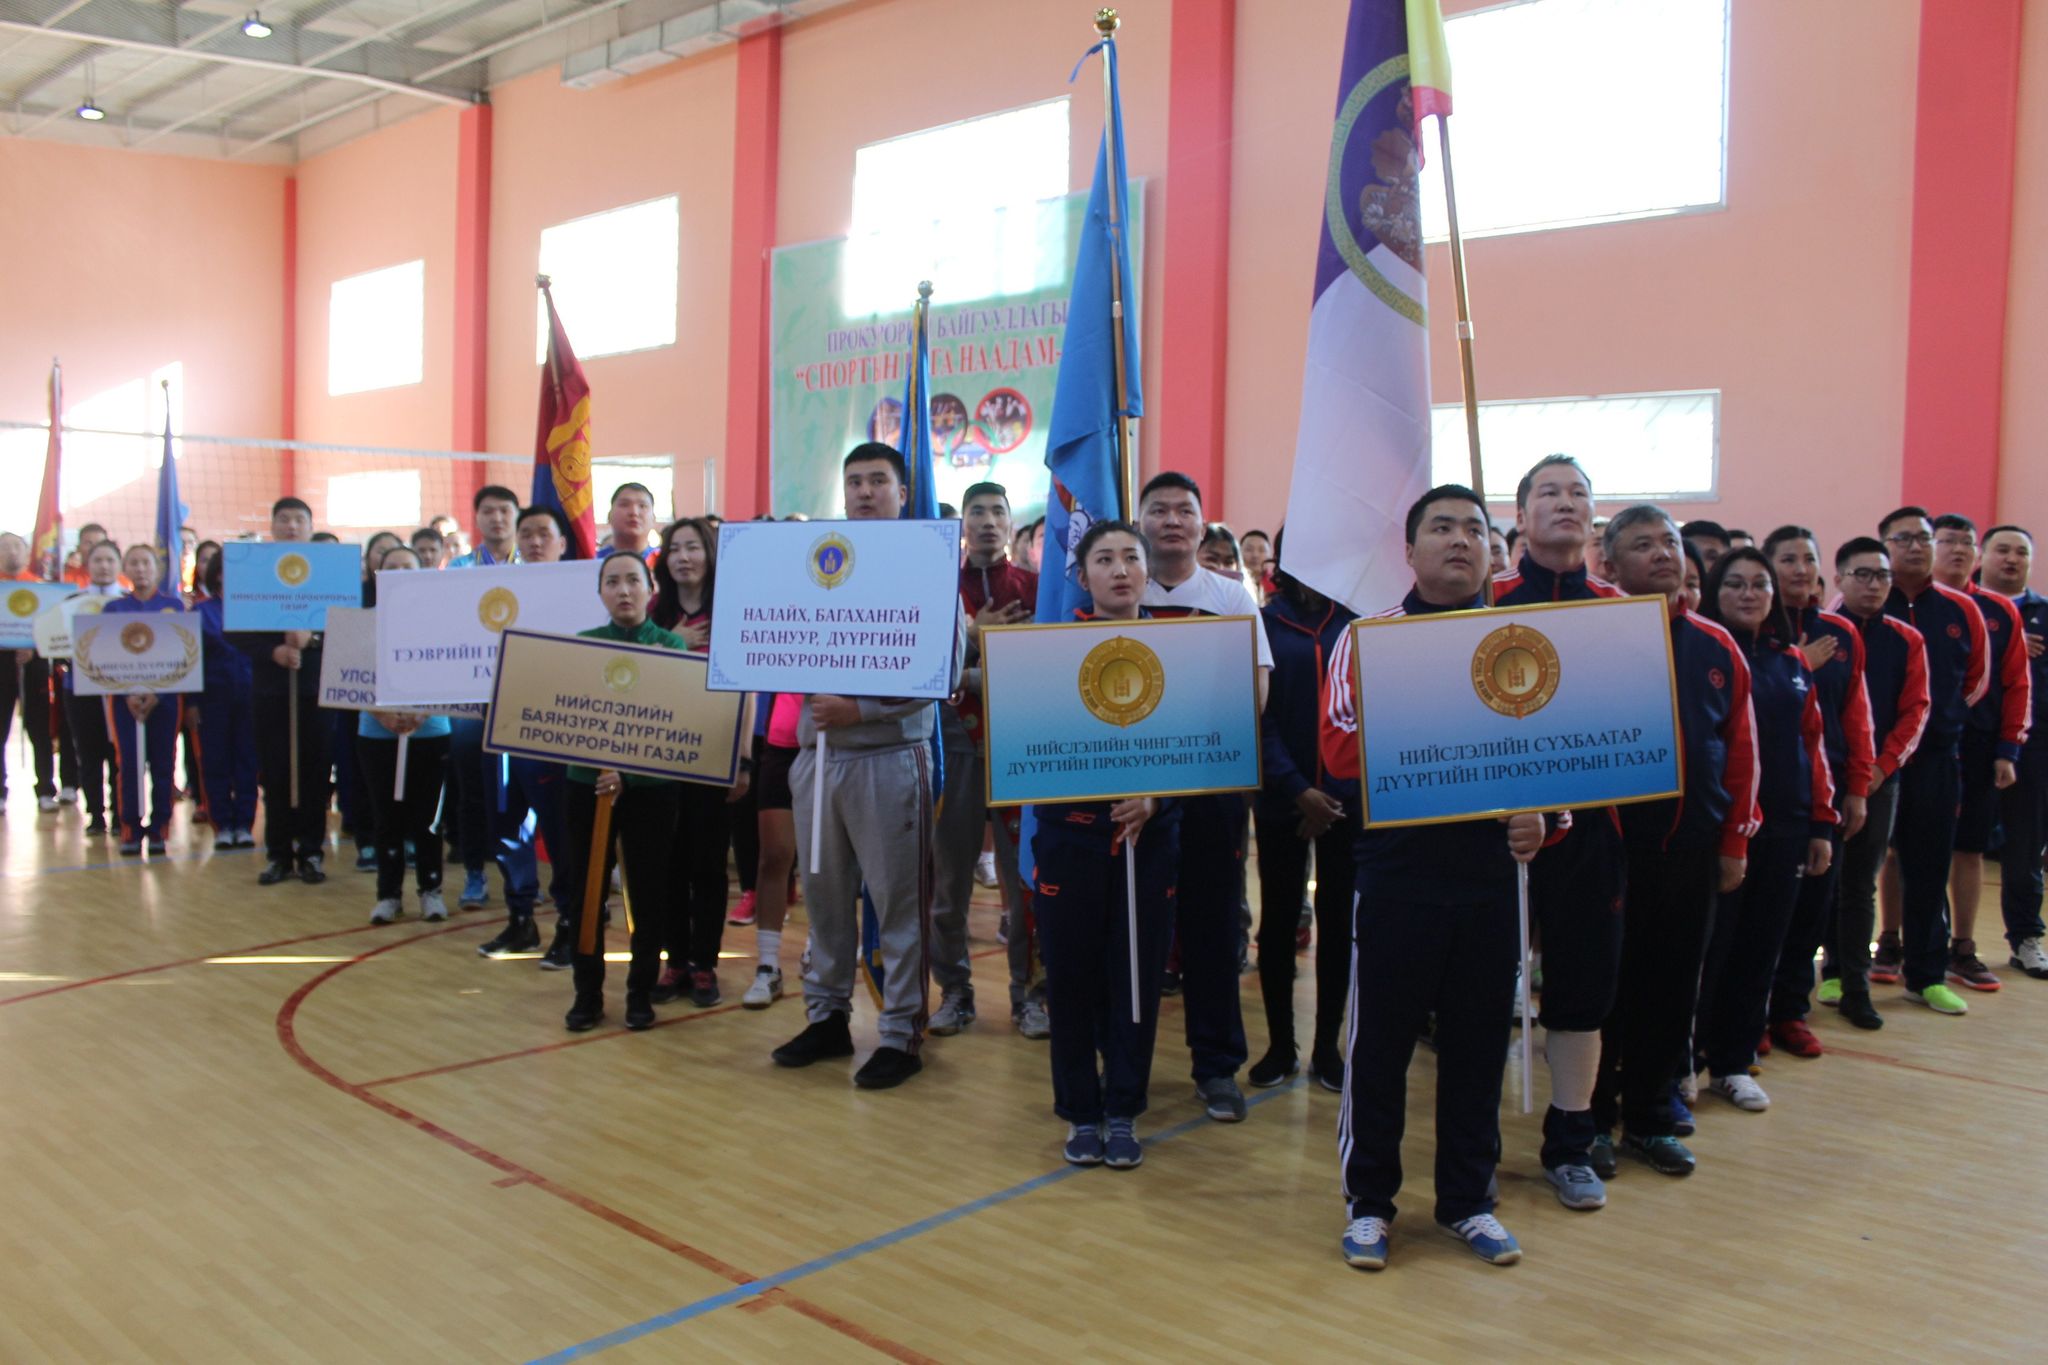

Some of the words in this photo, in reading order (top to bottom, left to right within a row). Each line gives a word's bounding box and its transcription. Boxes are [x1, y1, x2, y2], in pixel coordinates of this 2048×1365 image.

[827, 318, 933, 353] ПРОКУРОР
[937, 300, 1067, 338] БАЙГУУЛЛАГЫ
[905, 347, 953, 378] ГА
[743, 605, 811, 624] НАЛАЙХ,
[815, 606, 920, 624] БАГАХАНГАЙ
[740, 629, 819, 647] БАГАНУУР,
[393, 645, 481, 662] ТЭЭВРИЙН
[746, 652, 856, 669] ПРОКУРОРЫН
[861, 655, 910, 671] ГАЗАР
[555, 694, 673, 723] НИЙСЛЭЛИЙН
[519, 726, 638, 757] ПРОКУРОРЫН
[644, 745, 699, 765] ГАЗАР
[1026, 737, 1129, 757] НИЙСЛЭЛИЙН
[1133, 731, 1221, 751] ЧИНГЭЛТЭЙ
[1399, 736, 1529, 767] НИЙСЛЭЛИЙН
[1534, 727, 1642, 753] СҮХБААТАР
[1093, 752, 1193, 770] ПРОКУРОРЫН
[1198, 749, 1241, 764] ГАЗАР
[1483, 754, 1609, 781] ПРОКУРОРЫН
[1614, 747, 1668, 768] ГАЗАР
